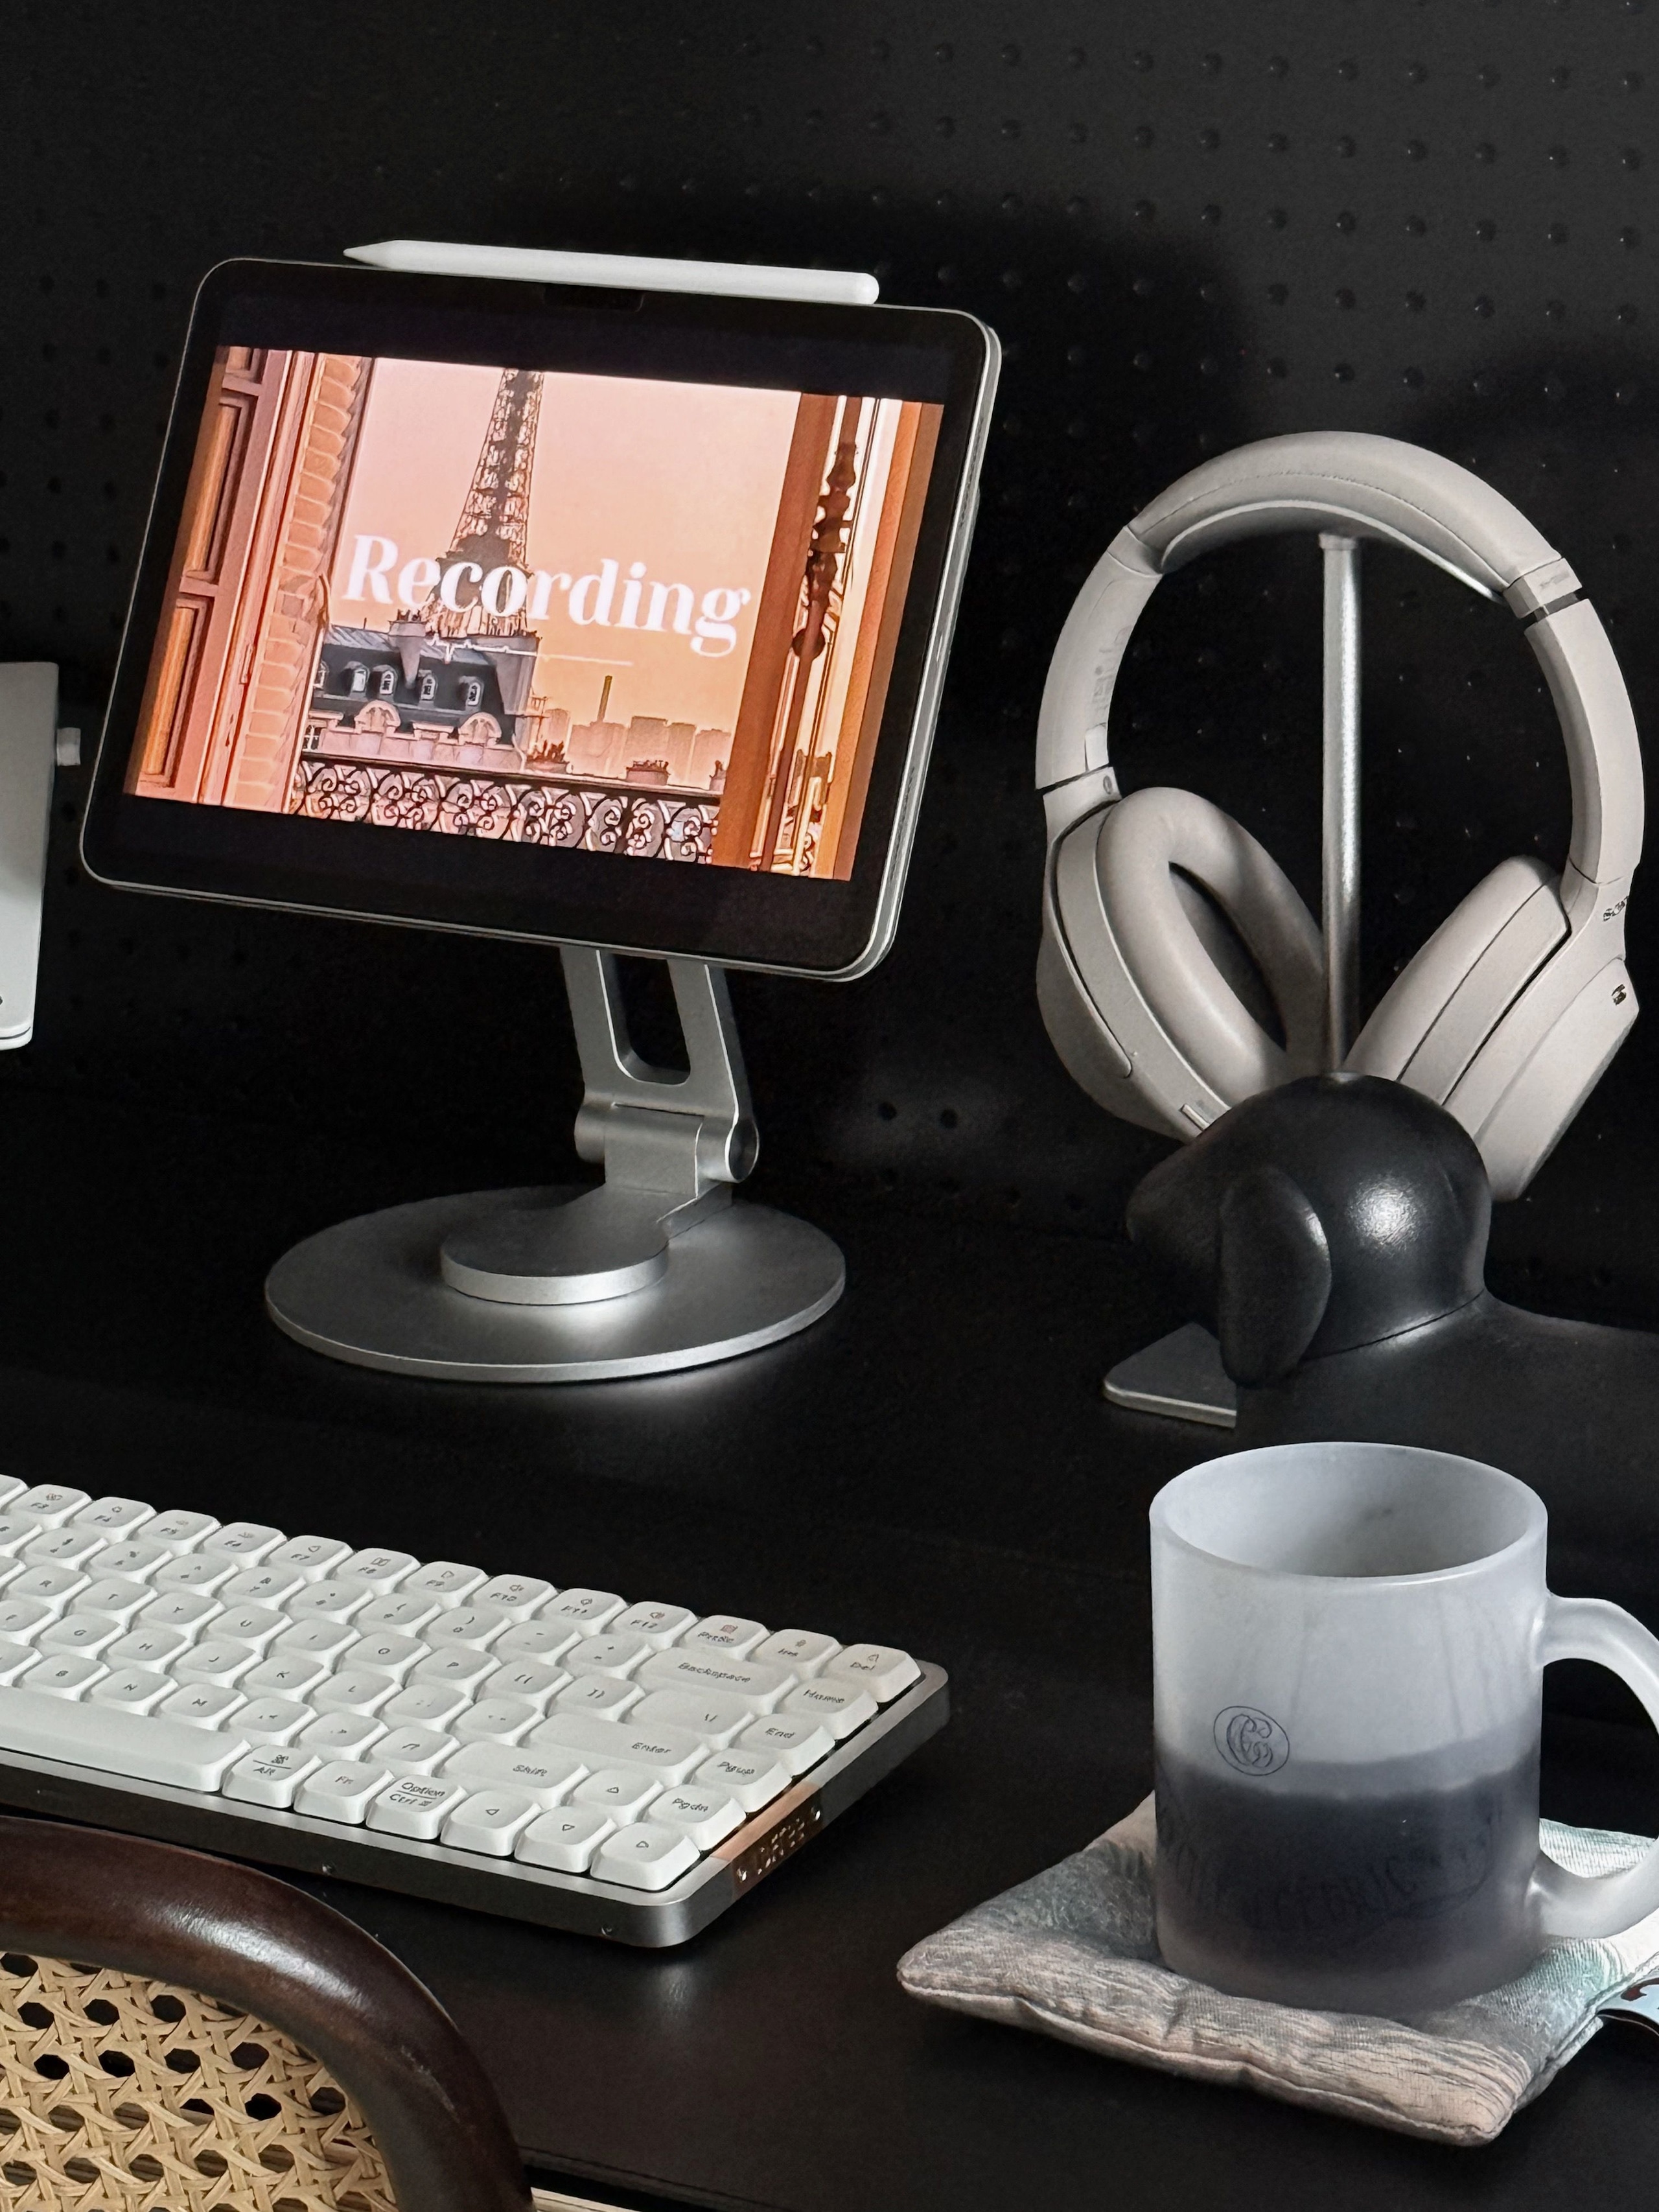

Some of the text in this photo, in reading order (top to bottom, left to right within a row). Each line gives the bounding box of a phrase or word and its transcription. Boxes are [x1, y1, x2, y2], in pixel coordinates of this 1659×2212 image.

[342, 534, 752, 657] Recording
[677, 1660, 752, 1683] Backspace
[803, 1689, 845, 1704] Home
[765, 1727, 795, 1739] End
[631, 1742, 671, 1754] Enter
[513, 1764, 548, 1777] Shift
[401, 1782, 445, 1797] Option
[389, 1793, 418, 1804] Ctrl
